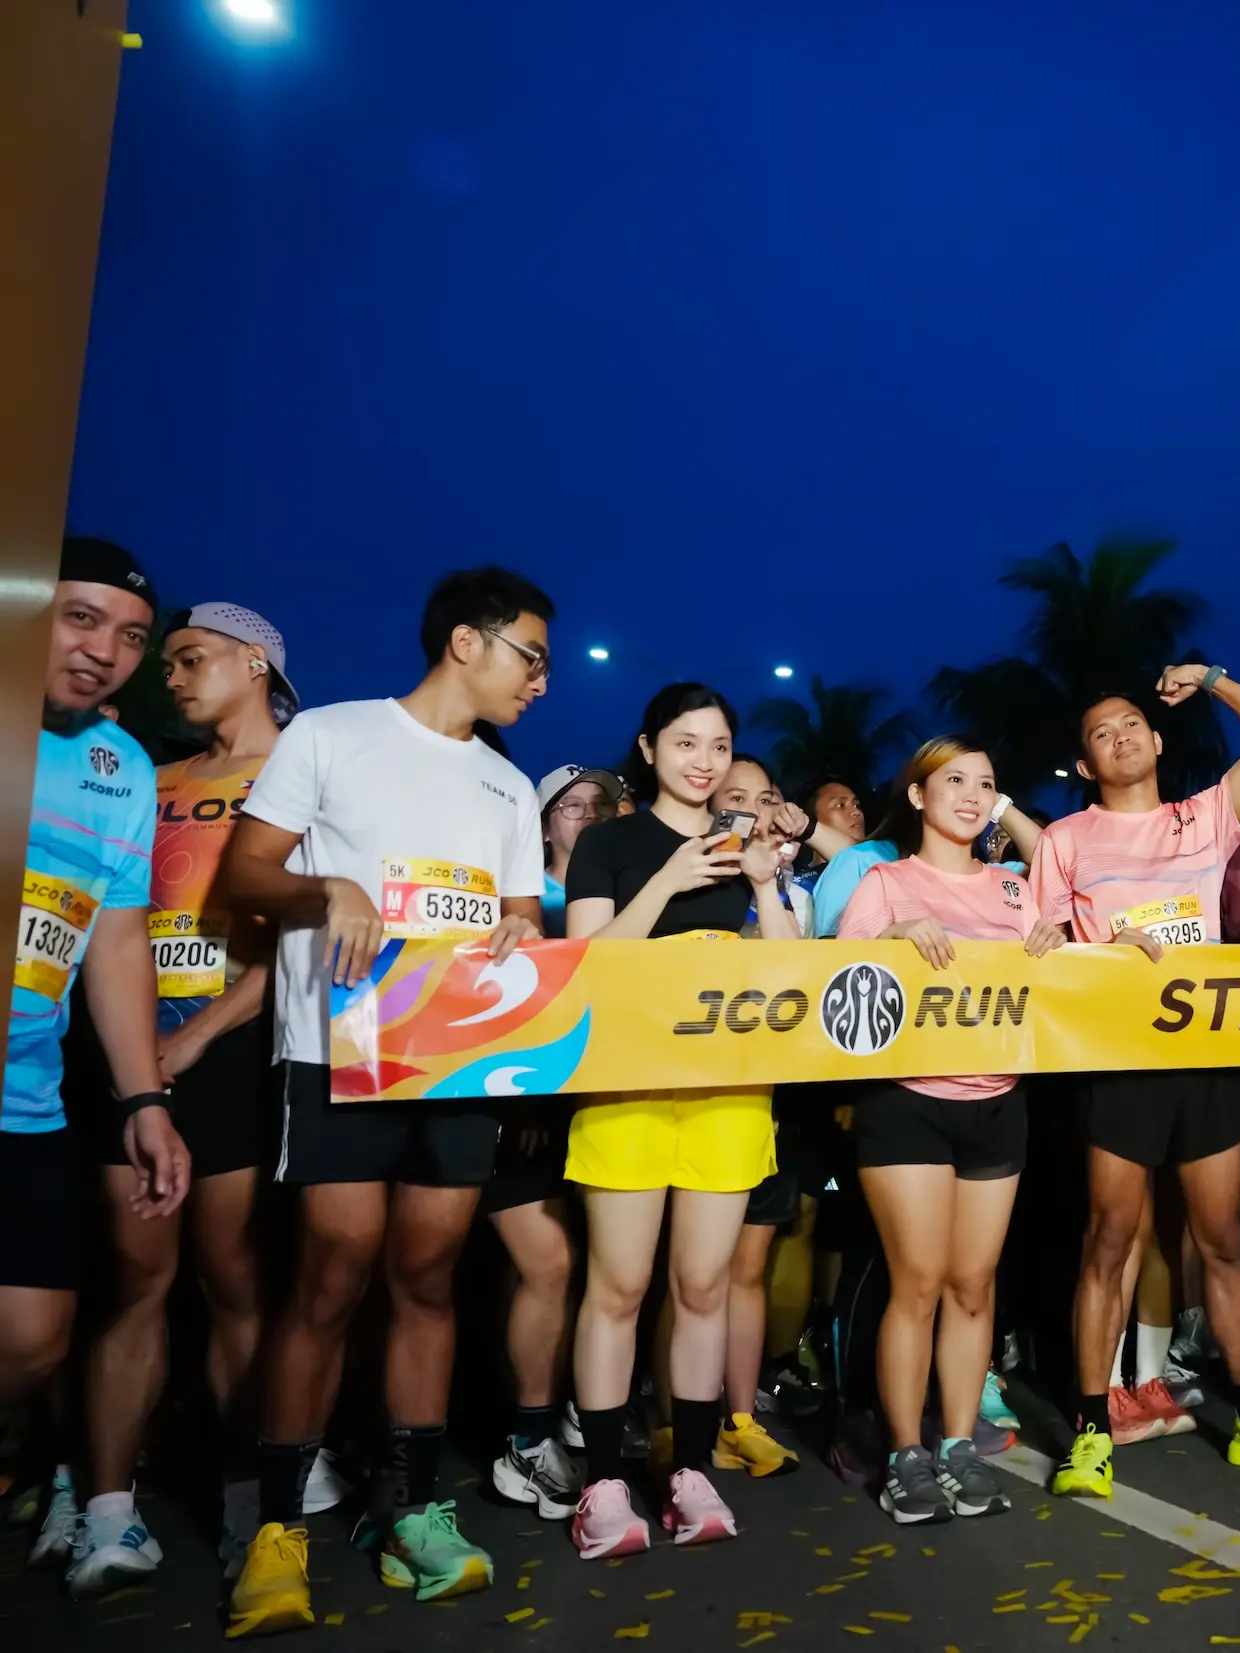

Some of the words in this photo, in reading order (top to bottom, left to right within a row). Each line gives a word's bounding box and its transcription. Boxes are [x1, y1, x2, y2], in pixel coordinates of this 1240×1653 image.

[480, 780, 505, 797] TEAM
[156, 798, 247, 822] LOS
[389, 865, 405, 877] 5K
[422, 867, 450, 878] JCO
[471, 874, 494, 886] RUN
[387, 890, 403, 910] M
[426, 893, 493, 925] 53323
[1179, 901, 1197, 911] RUN
[1115, 917, 1129, 929] 5K
[24, 916, 76, 965] 13312
[673, 989, 809, 1035] JCO
[914, 986, 1029, 1028] RUN
